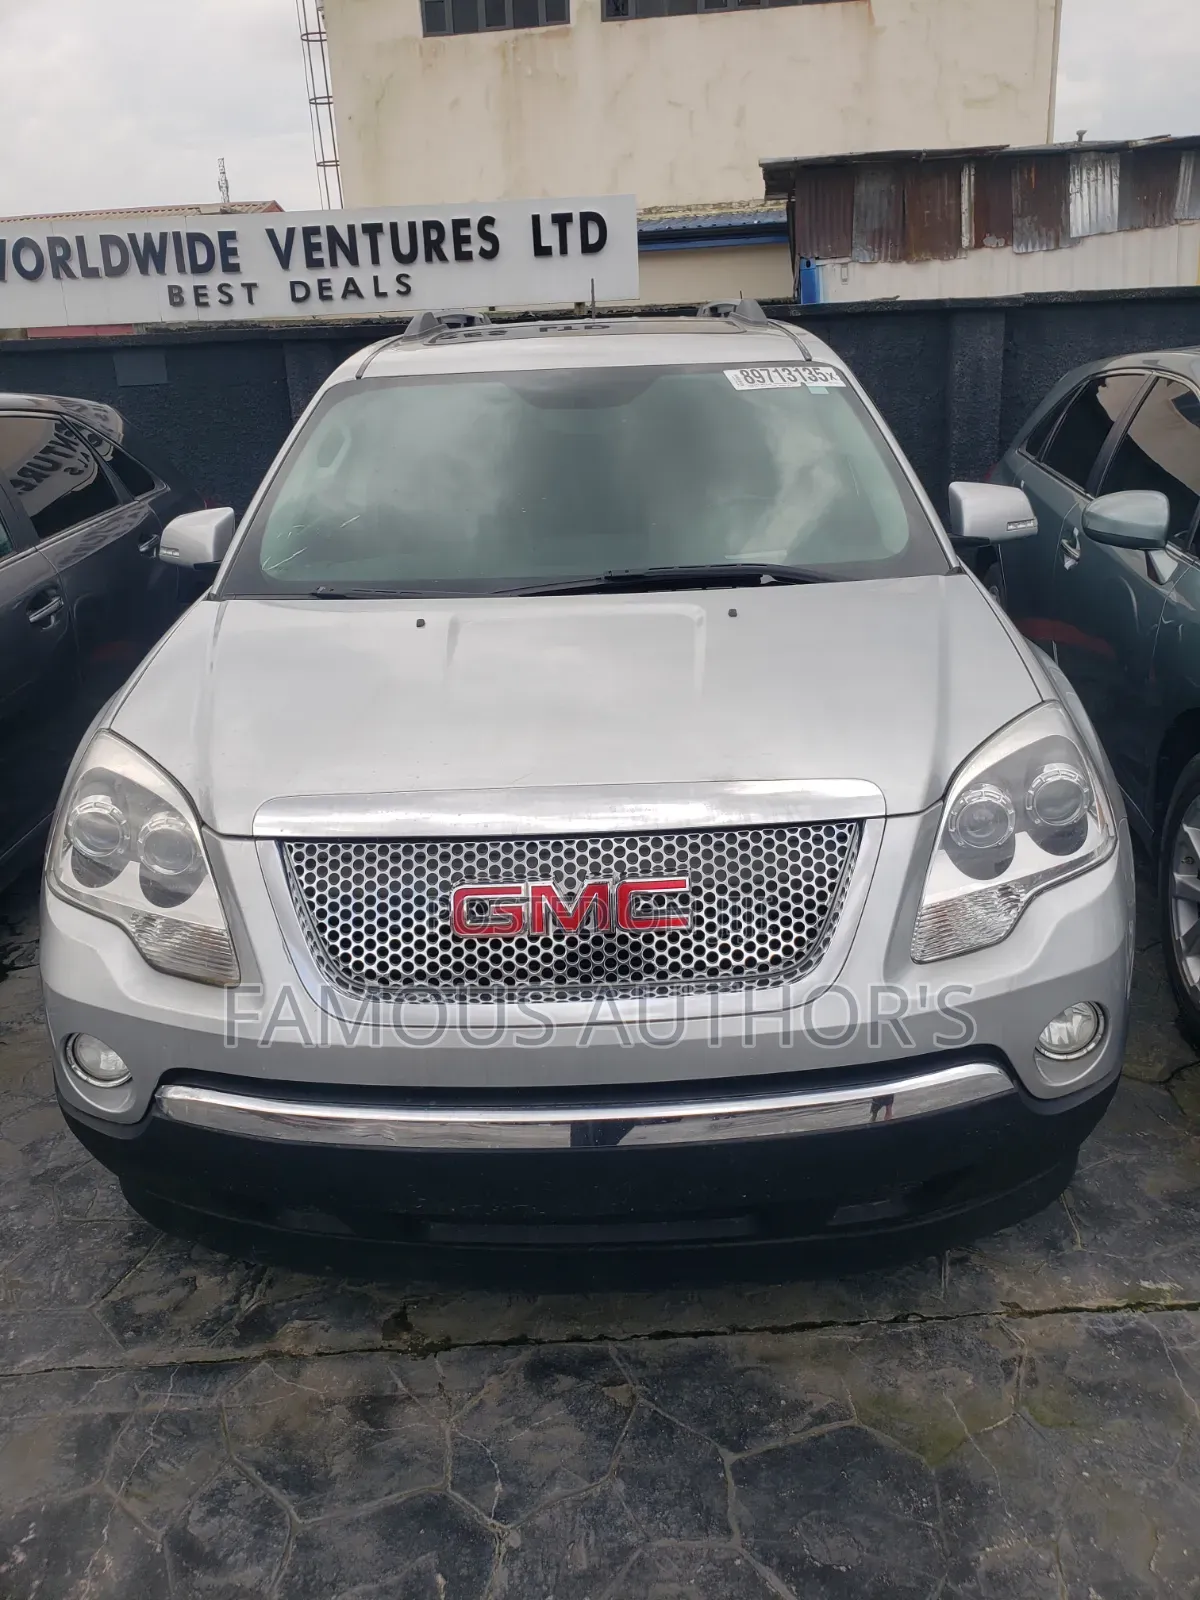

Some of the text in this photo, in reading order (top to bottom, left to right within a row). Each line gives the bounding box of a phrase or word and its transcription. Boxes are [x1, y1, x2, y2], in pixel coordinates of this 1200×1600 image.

[265, 215, 500, 271] VENTURES
[531, 211, 608, 258] LTD
[167, 273, 413, 308] BEST DEALS
[449, 876, 692, 940] GMC
